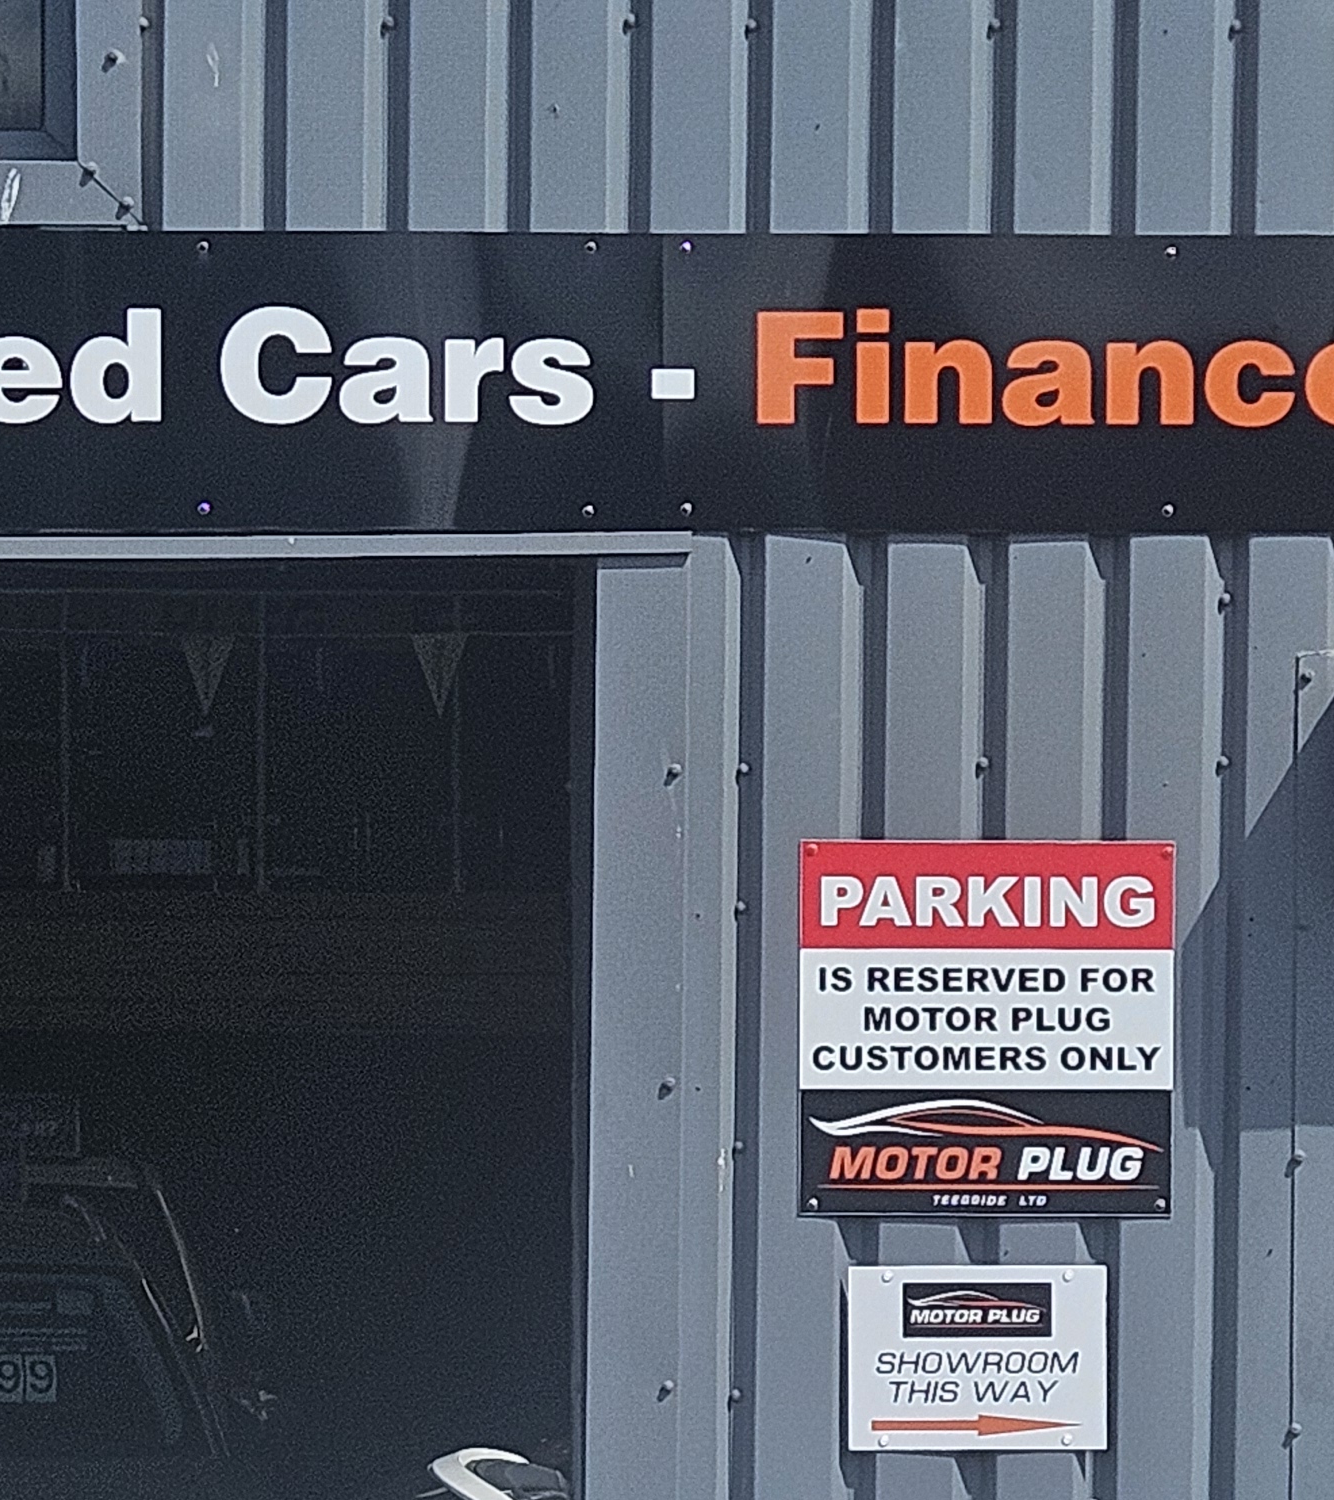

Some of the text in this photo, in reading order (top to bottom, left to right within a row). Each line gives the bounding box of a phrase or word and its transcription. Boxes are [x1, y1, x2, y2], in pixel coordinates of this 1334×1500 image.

[220, 306, 594, 426] Cars
[820, 875, 1155, 928] PARKING
[819, 967, 1154, 993] IS RESERVED FOR
[864, 1006, 1110, 1032] MOTOR PLUG
[812, 1045, 1160, 1071] CUSTOMERS ONLY
[829, 1146, 1143, 1181] MOTOR PLUG
[1018, 1195, 1047, 1206] LTD
[910, 1308, 1042, 1325] MOTOR PLUG
[875, 1351, 1079, 1375] SHOWROOM
[889, 1380, 1058, 1404] THIS WAY
